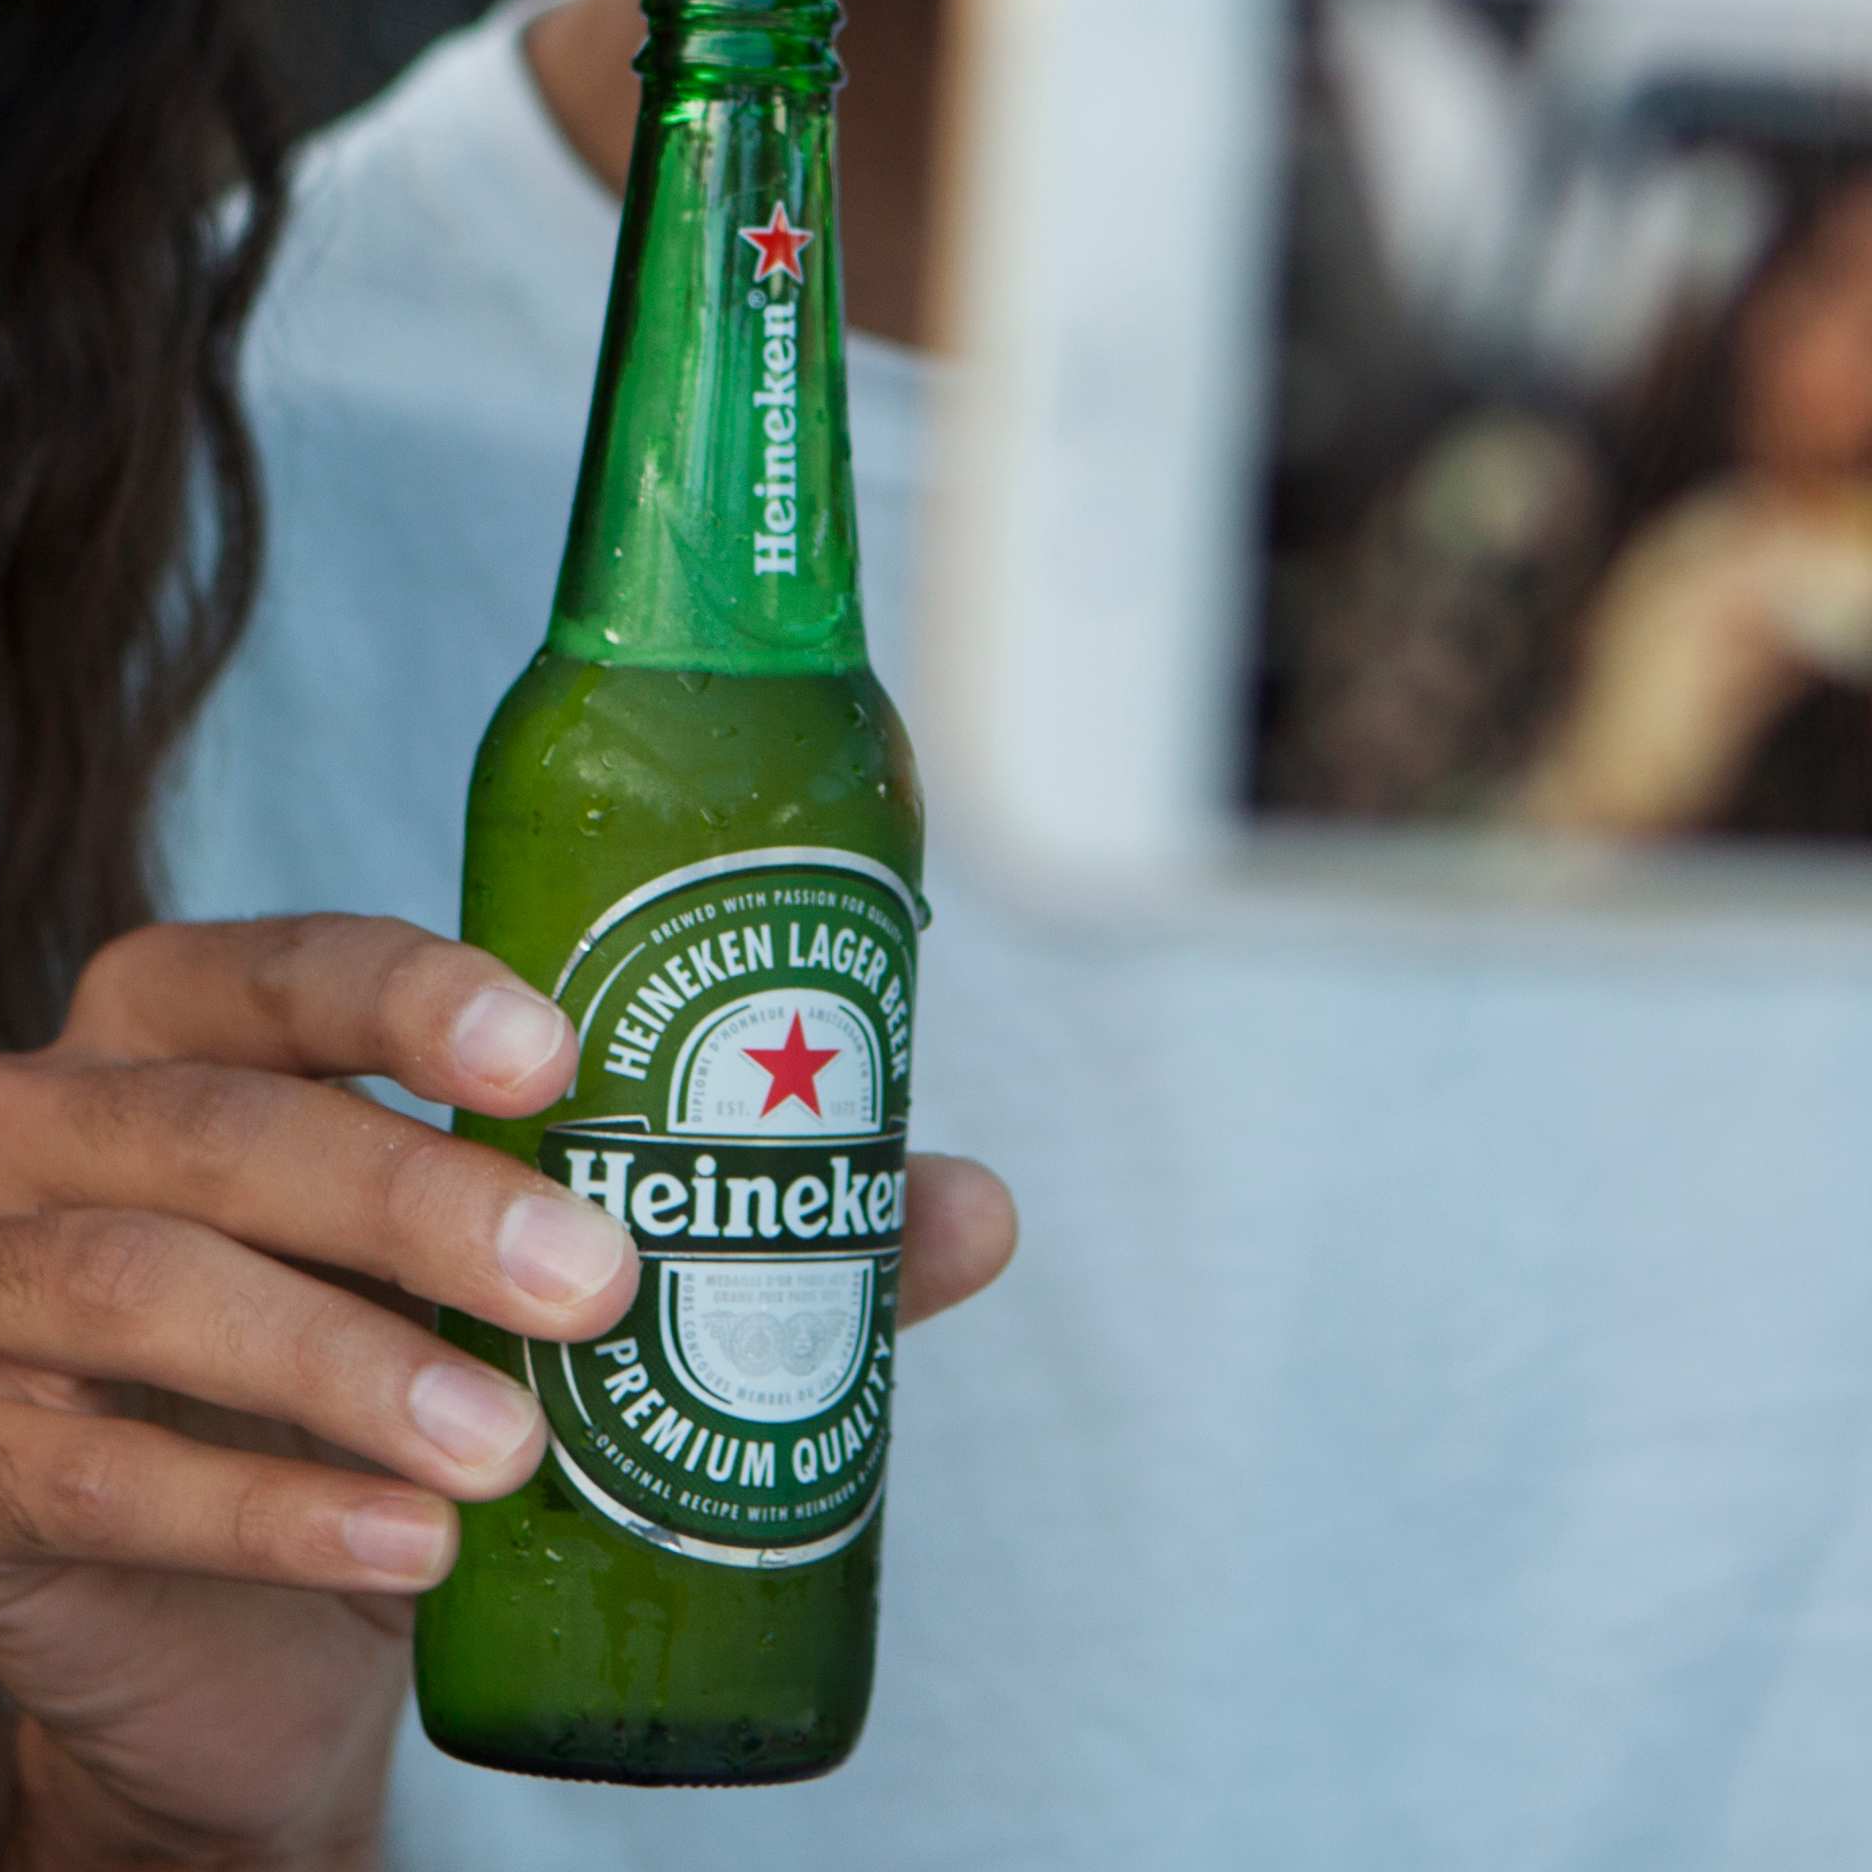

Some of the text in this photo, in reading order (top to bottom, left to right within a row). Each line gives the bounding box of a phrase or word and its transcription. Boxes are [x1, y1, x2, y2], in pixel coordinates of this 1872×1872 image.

[753, 300, 796, 575] Heineken
[650, 903, 717, 944] BREWED
[723, 891, 766, 913] WITH
[774, 889, 836, 907] PASSION
[841, 894, 864, 915] FOR
[604, 921, 909, 1081] HEINEKEN LAGER BEER
[595, 1336, 776, 1488] PREMIUM
[791, 1331, 893, 1484] QUALITY
[595, 1433, 672, 1500] ORIGINAL
[679, 1490, 740, 1521] RECIPE
[747, 1506, 789, 1522] WITH
